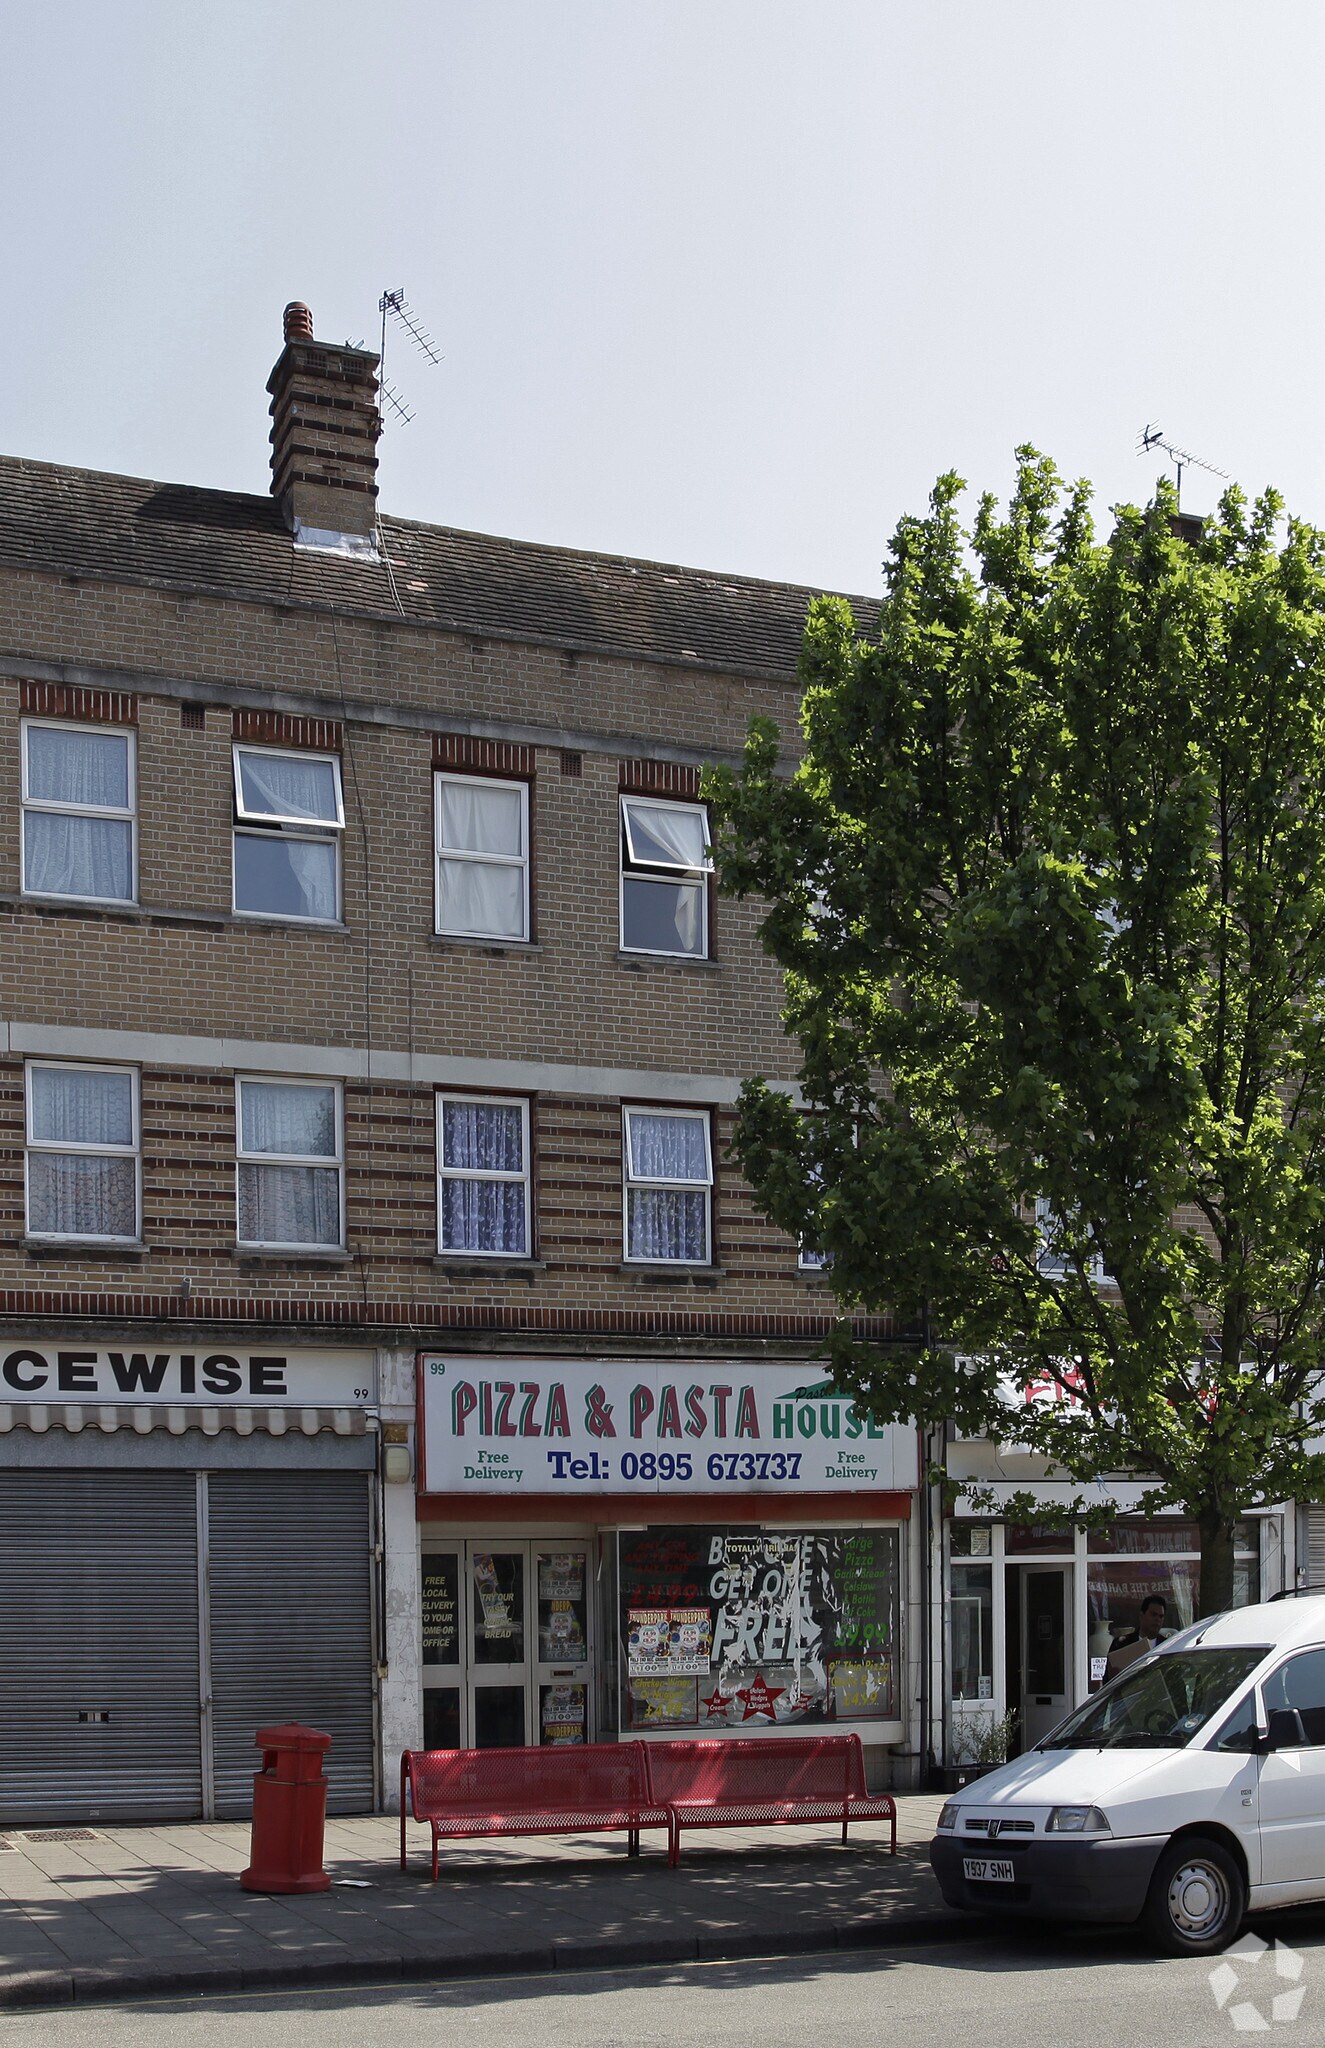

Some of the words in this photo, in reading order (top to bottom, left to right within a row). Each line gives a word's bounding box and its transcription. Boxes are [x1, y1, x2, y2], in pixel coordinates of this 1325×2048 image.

[2, 1349, 288, 1395] CEWISE
[430, 1363, 446, 1375] 99
[353, 1388, 369, 1399] 99
[451, 1380, 571, 1437] PIZZA
[584, 1383, 617, 1438] &
[629, 1383, 760, 1439] PASTA
[478, 1451, 509, 1463] Free
[837, 1451, 865, 1463] Free
[547, 1451, 610, 1480] Tel:
[620, 1452, 693, 1481] 0895
[707, 1453, 802, 1480] 673737
[463, 1467, 523, 1482] Delivery
[825, 1466, 878, 1481] Delivery
[844, 1552, 874, 1566] Pizza
[424, 1576, 446, 1585] FREE
[422, 1589, 448, 1597] LOCAL
[497, 1593, 514, 1601] OUR
[852, 1593, 876, 1604] Bottle
[422, 1601, 455, 1610] ELIVERY
[432, 1613, 453, 1622] YOUR
[856, 1607, 877, 1617] Coke
[422, 1626, 442, 1635] OME
[485, 1631, 512, 1639] BREAD
[422, 1638, 450, 1647] OFFICE
[990, 1862, 1013, 1879] SNH
